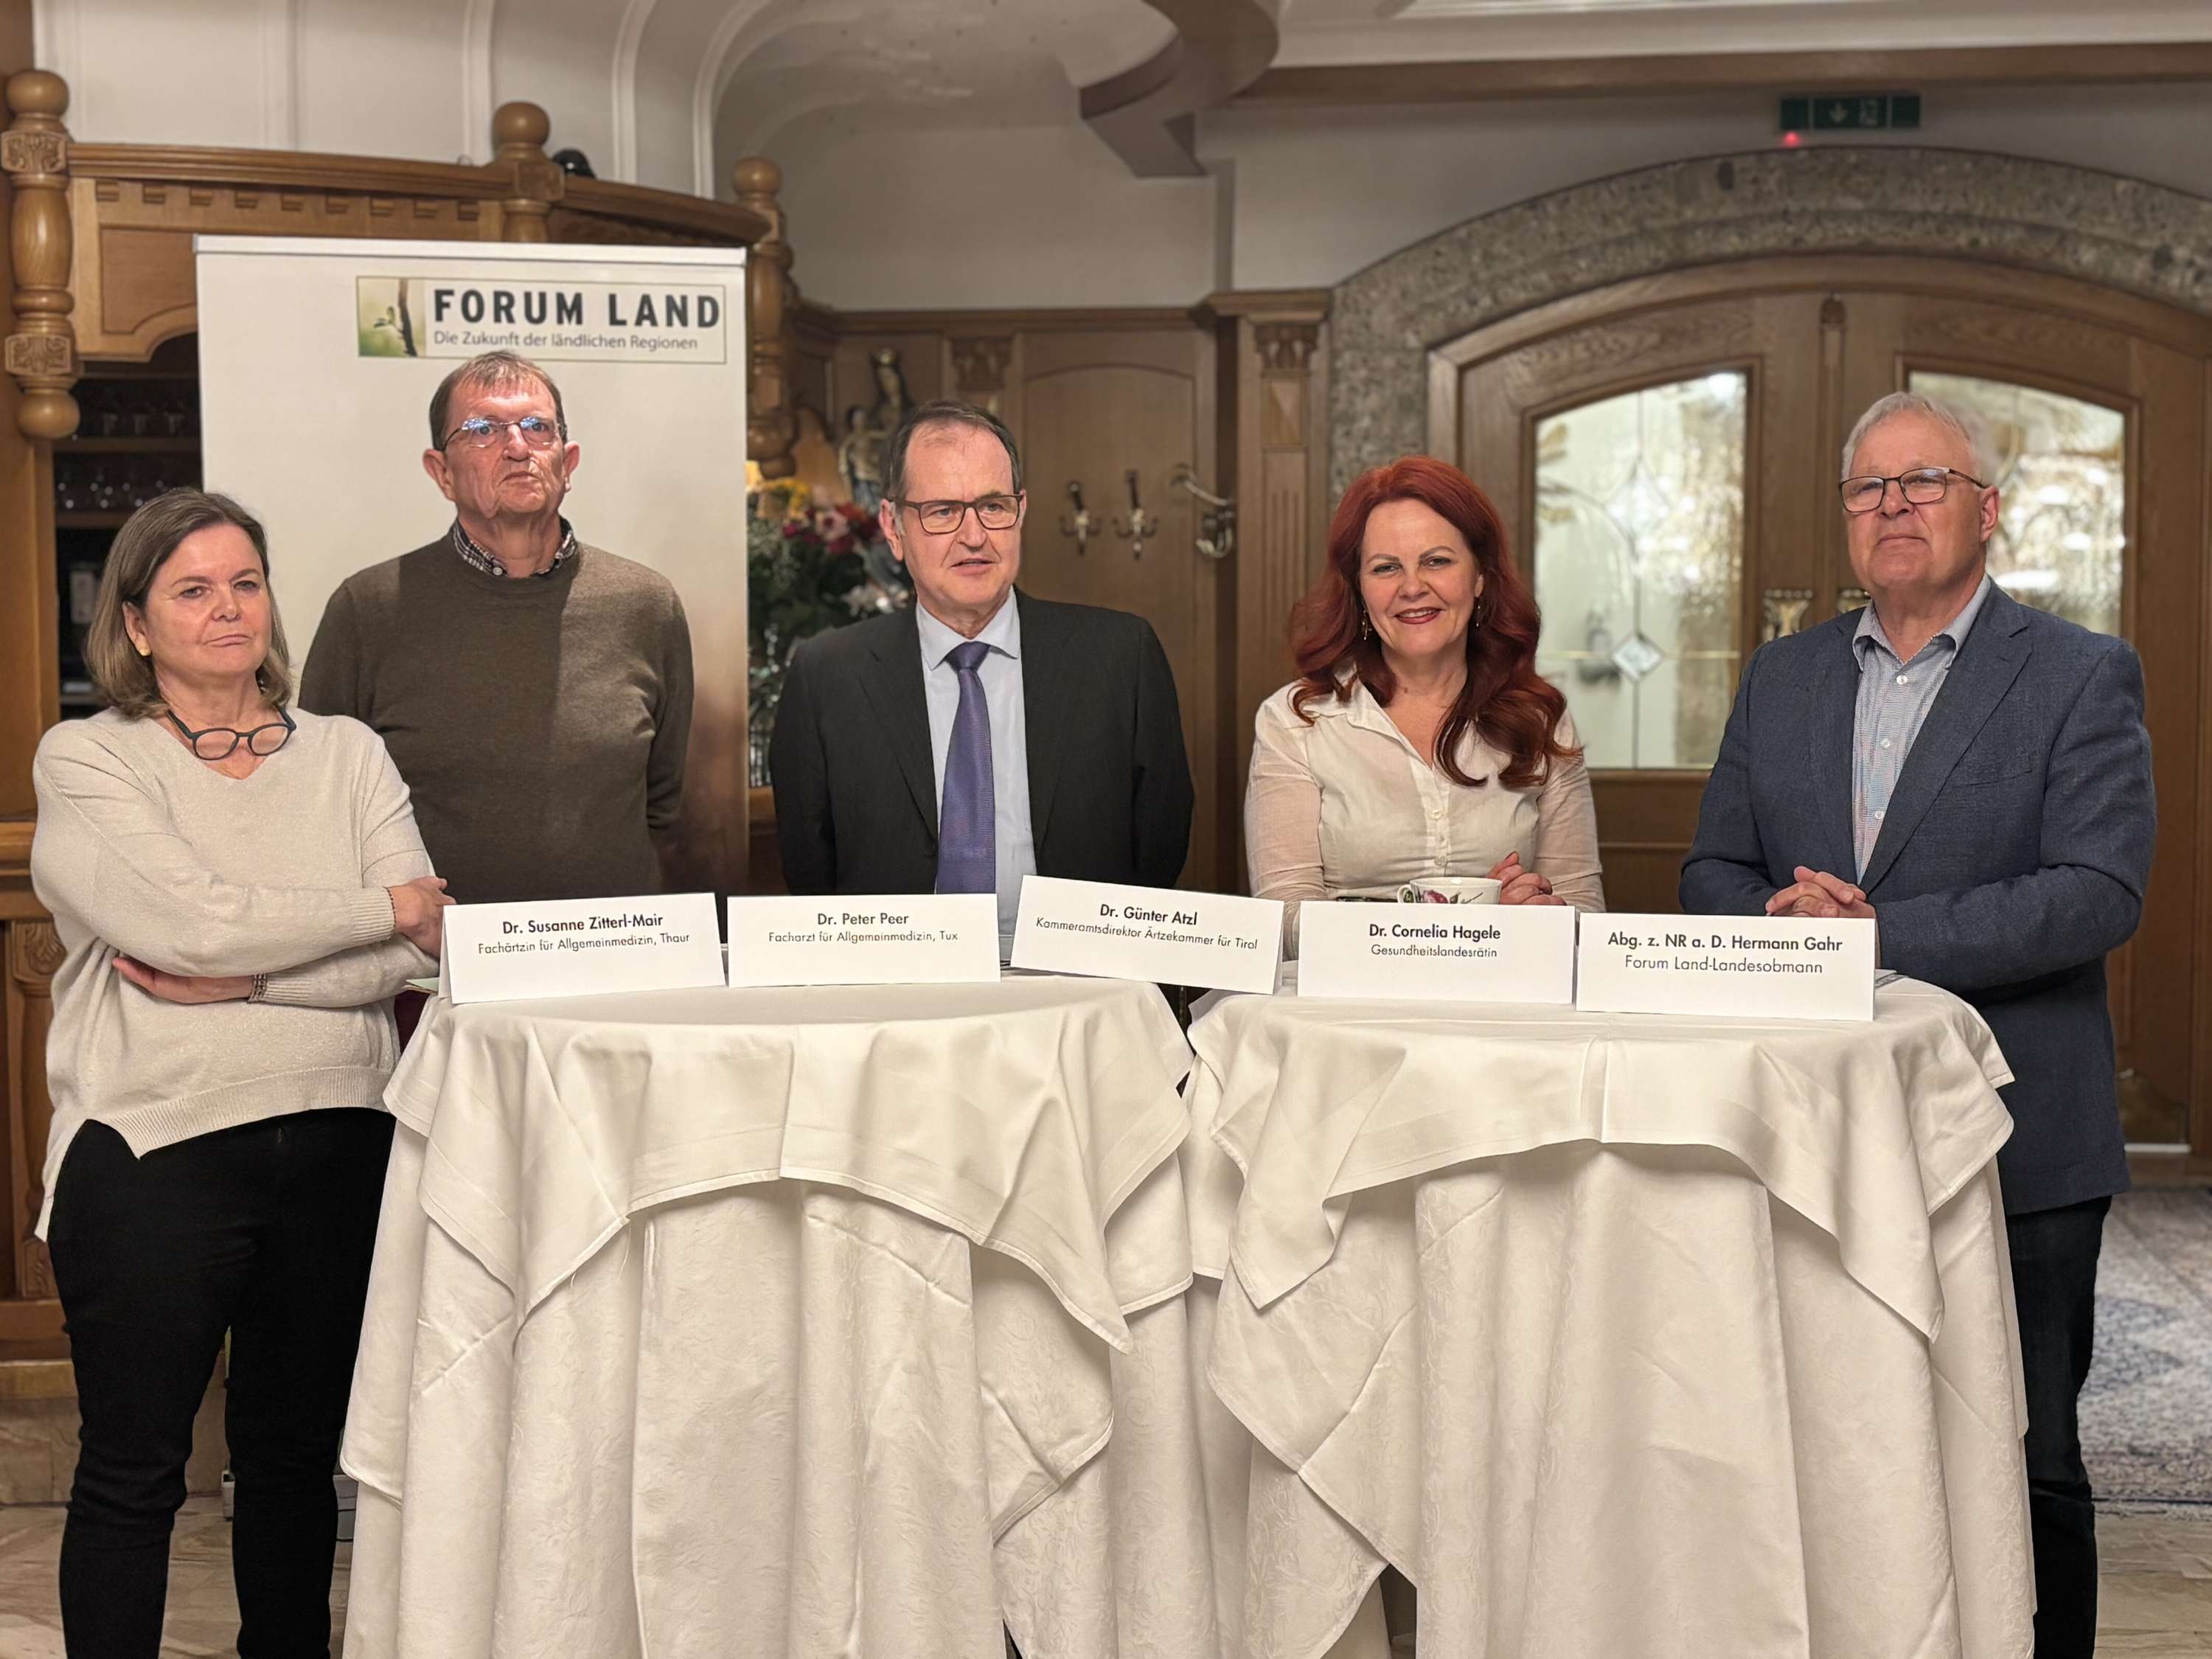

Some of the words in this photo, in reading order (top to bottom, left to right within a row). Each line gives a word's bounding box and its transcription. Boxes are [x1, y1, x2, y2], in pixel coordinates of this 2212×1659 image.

[434, 289, 583, 326] FORUM
[608, 293, 720, 328] LAND
[434, 331, 459, 345] Die
[463, 332, 519, 347] Zukunft
[524, 334, 546, 347] der
[552, 333, 626, 348] ländlichen
[630, 335, 698, 351] Regionen
[503, 921, 523, 934] Dr.
[529, 919, 584, 933] Susanne
[589, 914, 664, 930] Zitterl-Mair
[818, 914, 837, 925] Dr.
[843, 913, 875, 925] Peter
[880, 913, 908, 924] Peer
[1100, 905, 1118, 917] Dr.
[1124, 906, 1168, 923] Günter
[1172, 912, 1197, 925] Atzl
[540, 940, 553, 951] für
[557, 935, 656, 952] Allgemeinmedizin,
[660, 933, 689, 944] Thaur
[769, 932, 815, 942] Facharzt
[819, 932, 832, 942] für
[838, 931, 935, 945] Allgemeinmedizin,
[940, 931, 958, 940] Tux
[1037, 917, 1141, 938] Kammeramtsdirektor
[1218, 935, 1231, 947] für
[1236, 938, 1257, 950] Tirol
[1369, 924, 1386, 937] Dr.
[1392, 925, 1447, 939] Cornelia
[1453, 926, 1500, 942] Hagele
[1607, 932, 1642, 949] Abg.
[1648, 937, 1659, 947] z.
[1666, 934, 1687, 947] NR
[1692, 938, 1705, 948] a.
[1711, 936, 1725, 948] D.
[1732, 936, 1798, 950] Hermann
[1804, 936, 1843, 951] Gahr
[1371, 945, 1497, 958] Gesundheitslandesrätin
[1625, 955, 1668, 969] Forum
[1674, 957, 1823, 973] Land-Landesobmann
